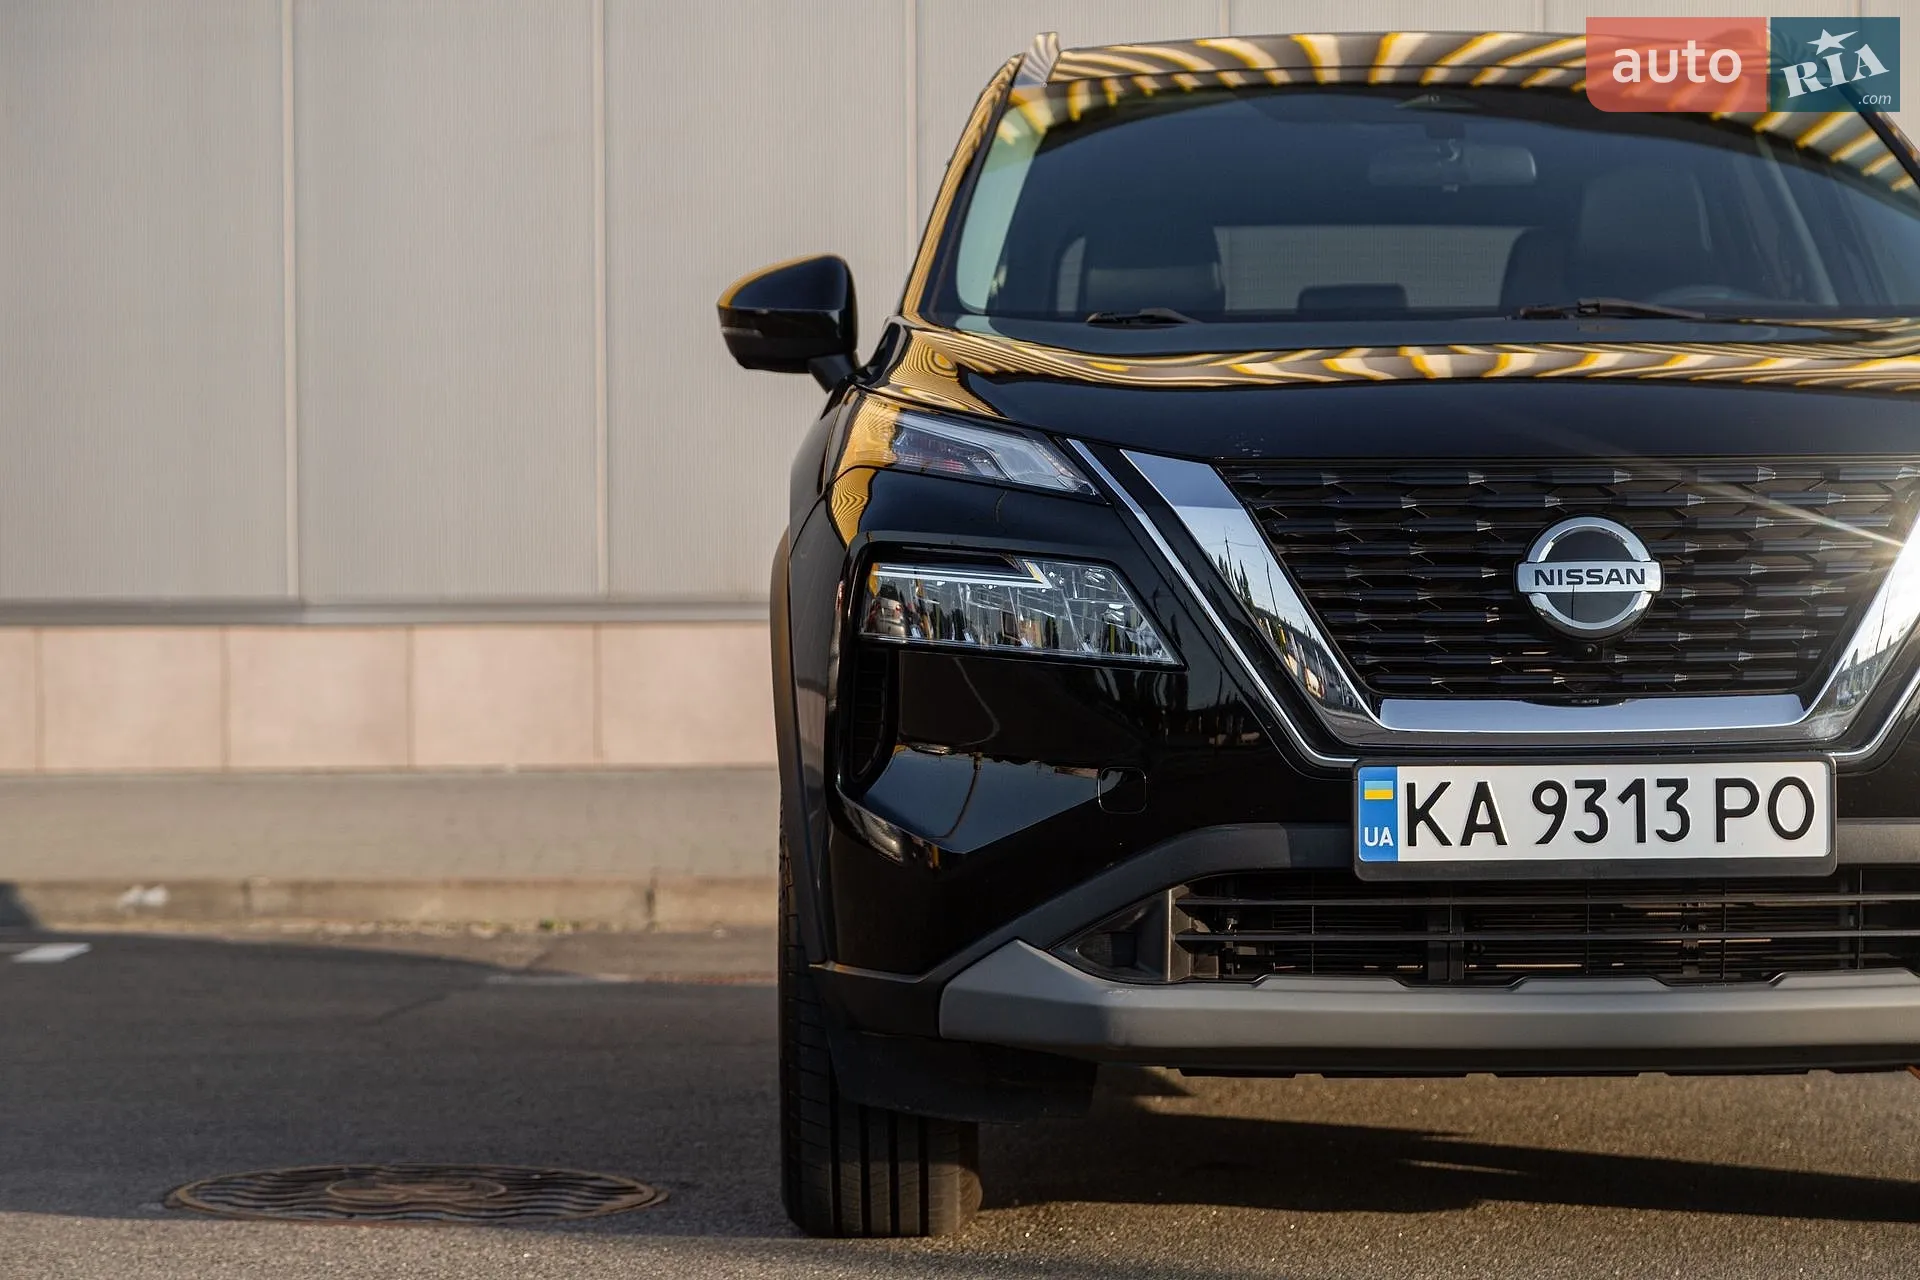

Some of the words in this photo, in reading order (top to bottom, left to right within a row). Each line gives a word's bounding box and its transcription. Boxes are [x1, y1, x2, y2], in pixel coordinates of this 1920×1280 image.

[1534, 568, 1645, 586] NISSAN
[1406, 780, 1508, 847] KA
[1531, 777, 1691, 845] 9313
[1715, 775, 1815, 843] PO
[1364, 826, 1394, 848] UA
